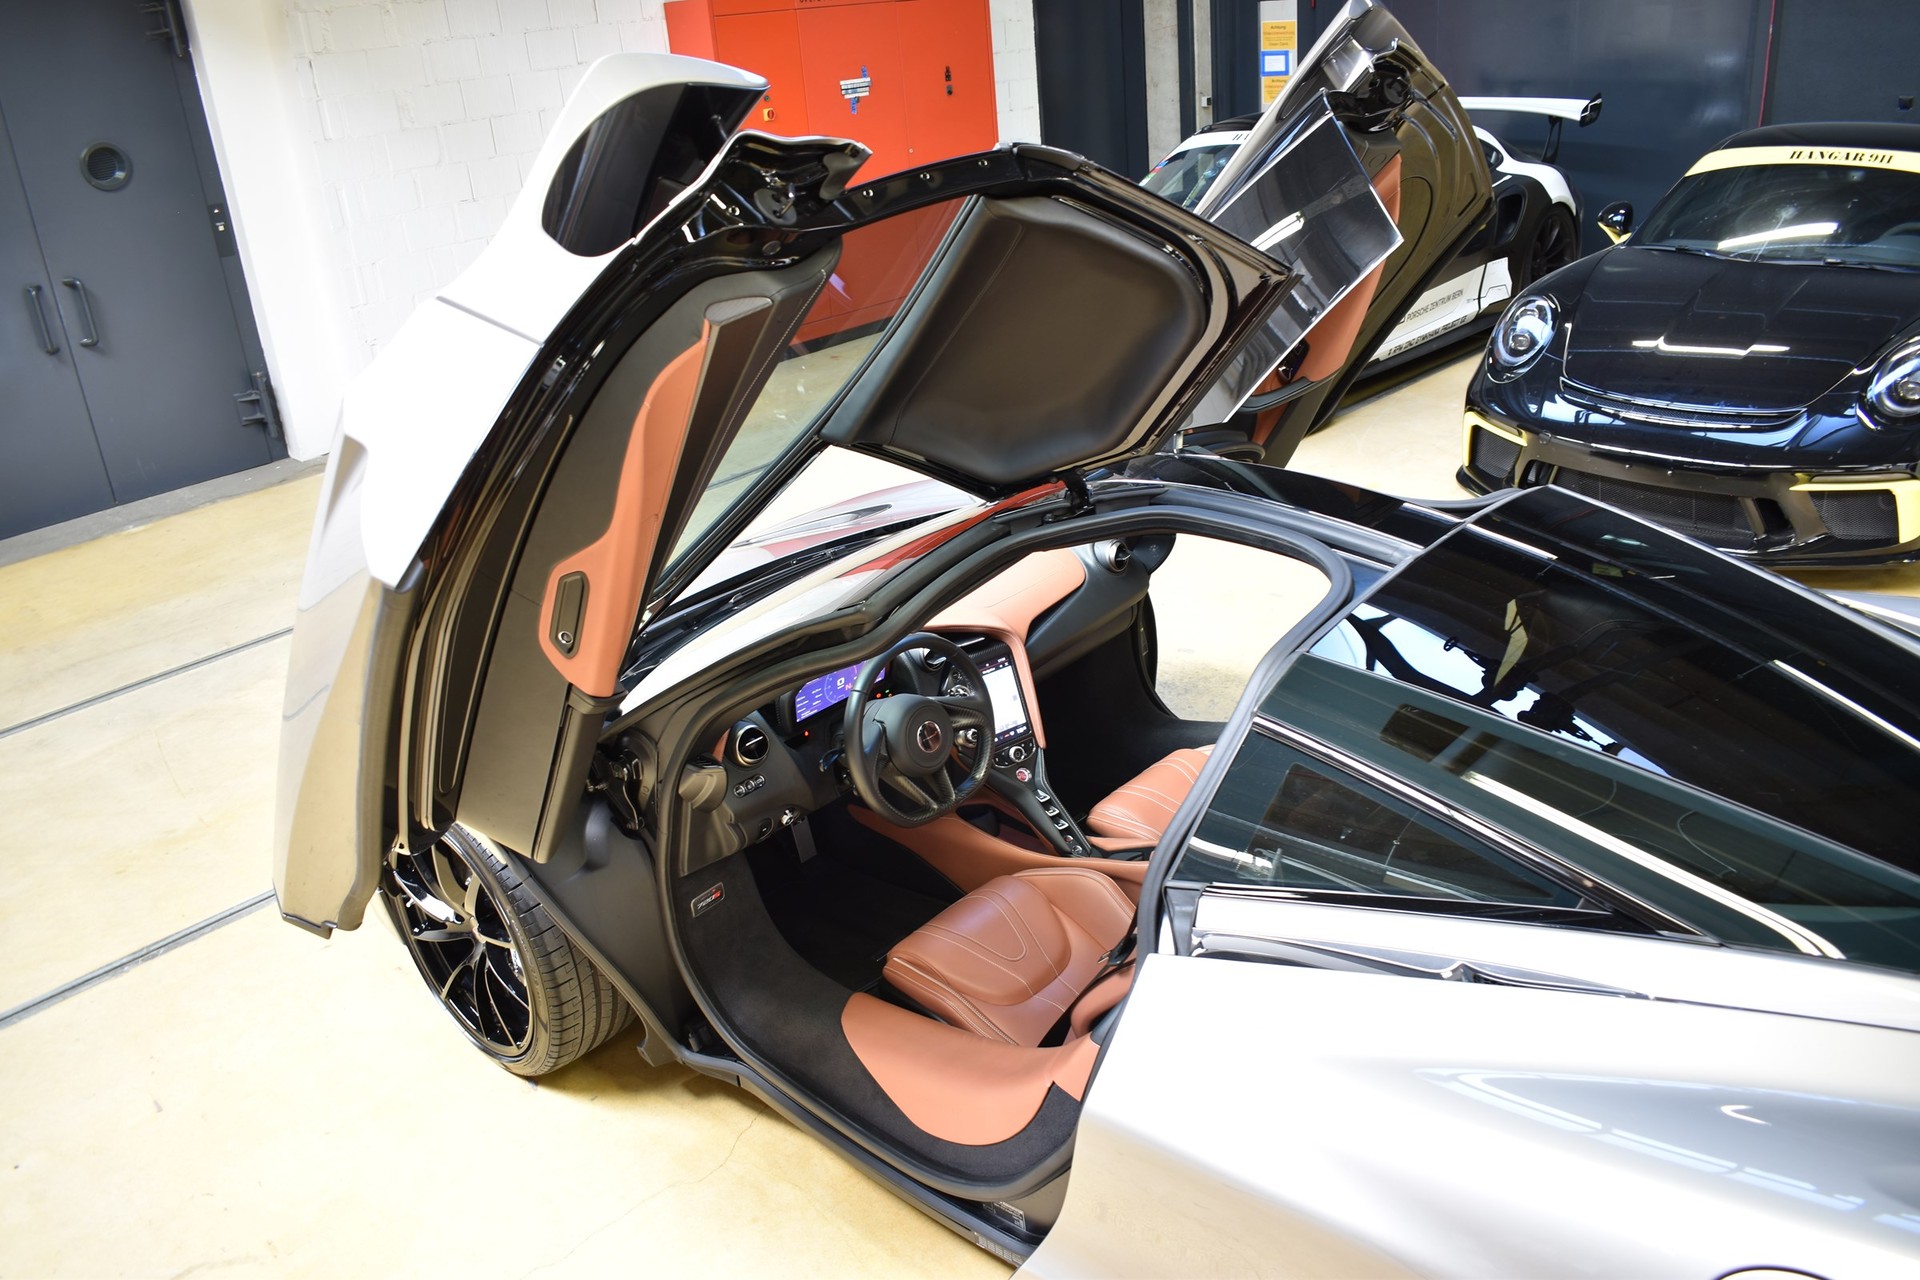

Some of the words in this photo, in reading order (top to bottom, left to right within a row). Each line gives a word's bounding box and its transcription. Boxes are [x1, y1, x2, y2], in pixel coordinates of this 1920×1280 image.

[1789, 151, 1865, 162] HANGAR
[1868, 153, 1893, 164] 911
[1406, 304, 1429, 321] PORSCHE
